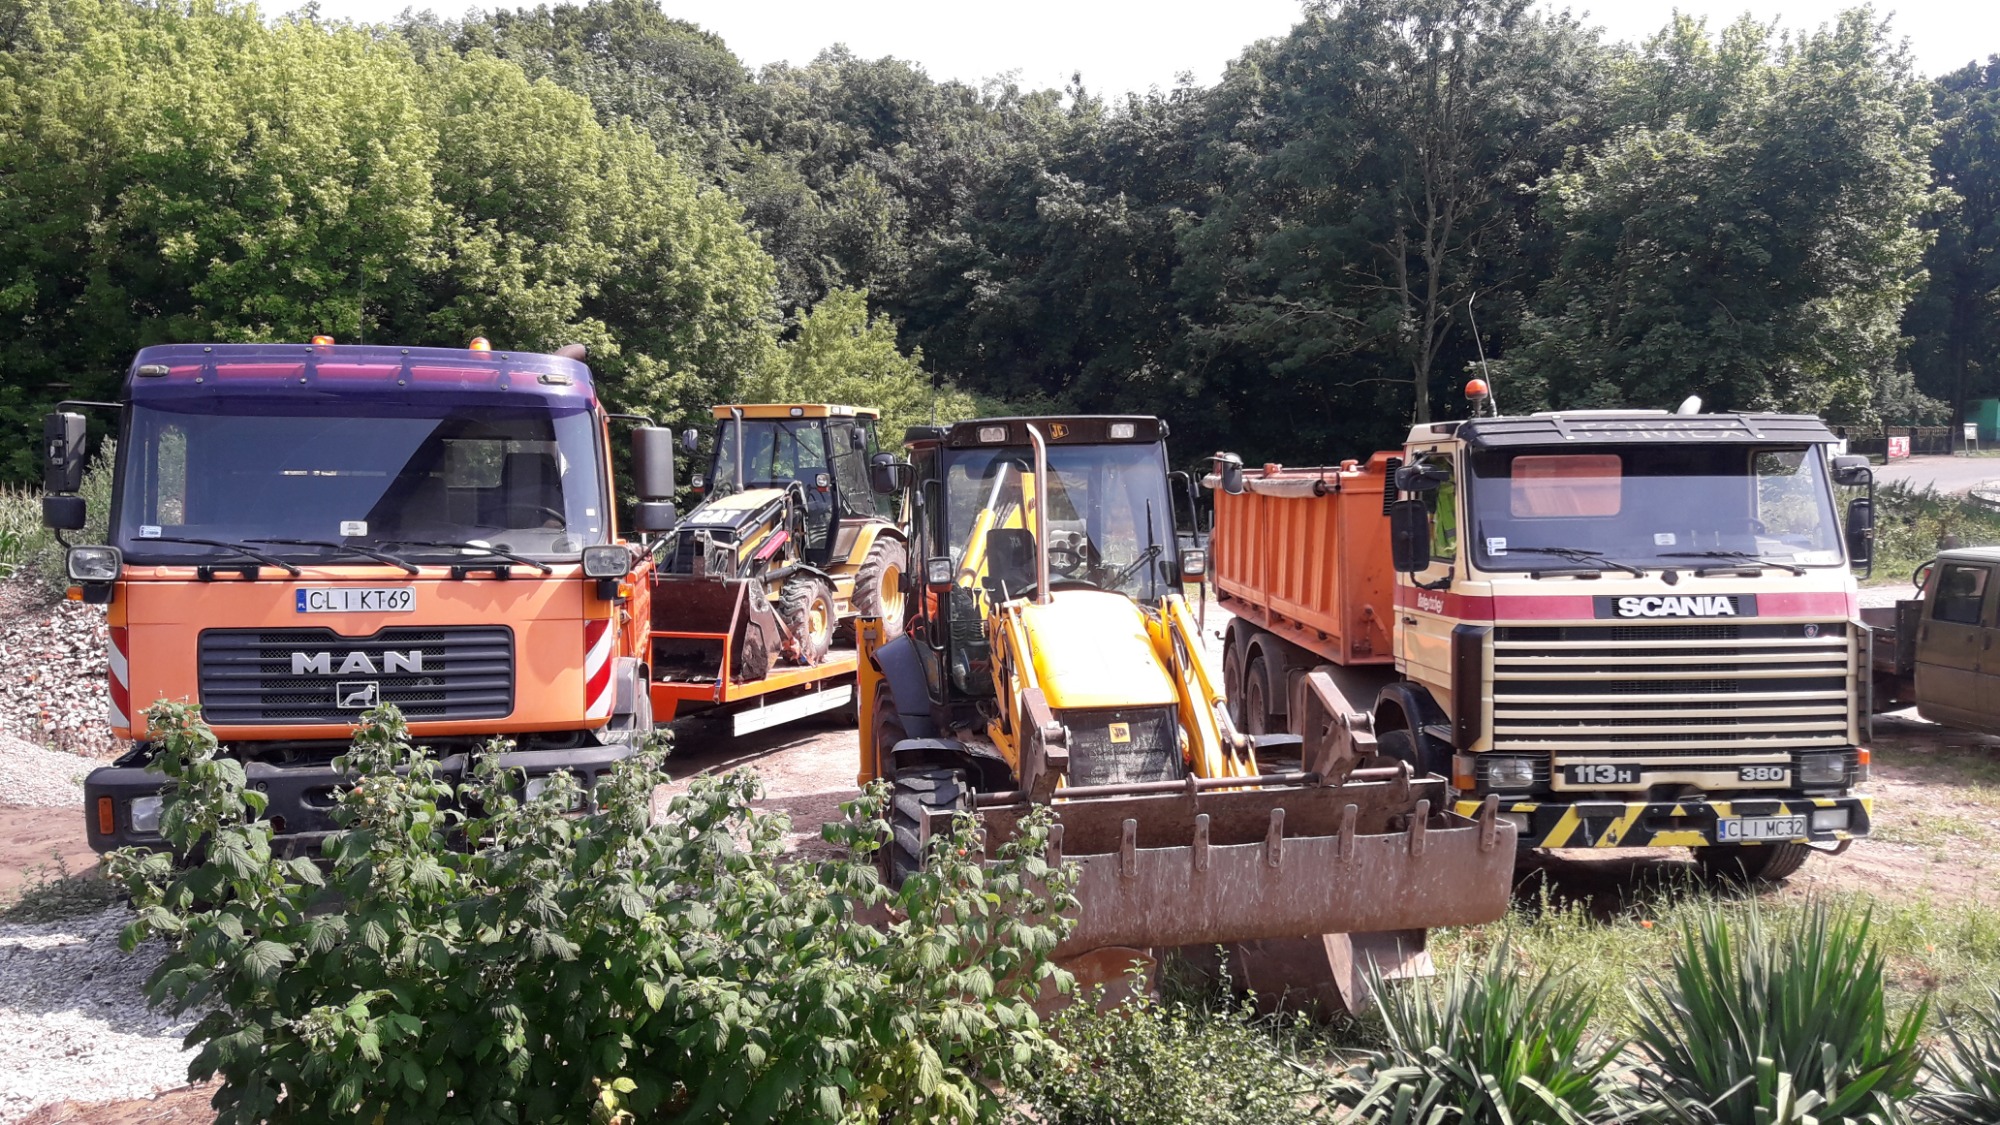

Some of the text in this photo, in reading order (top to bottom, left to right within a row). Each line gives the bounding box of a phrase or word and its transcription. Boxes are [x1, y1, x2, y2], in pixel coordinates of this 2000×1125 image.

[691, 510, 742, 524] CAT
[1617, 596, 1735, 617] SCANIA
[292, 650, 422, 674] MAN
[1741, 767, 1783, 781] 380
